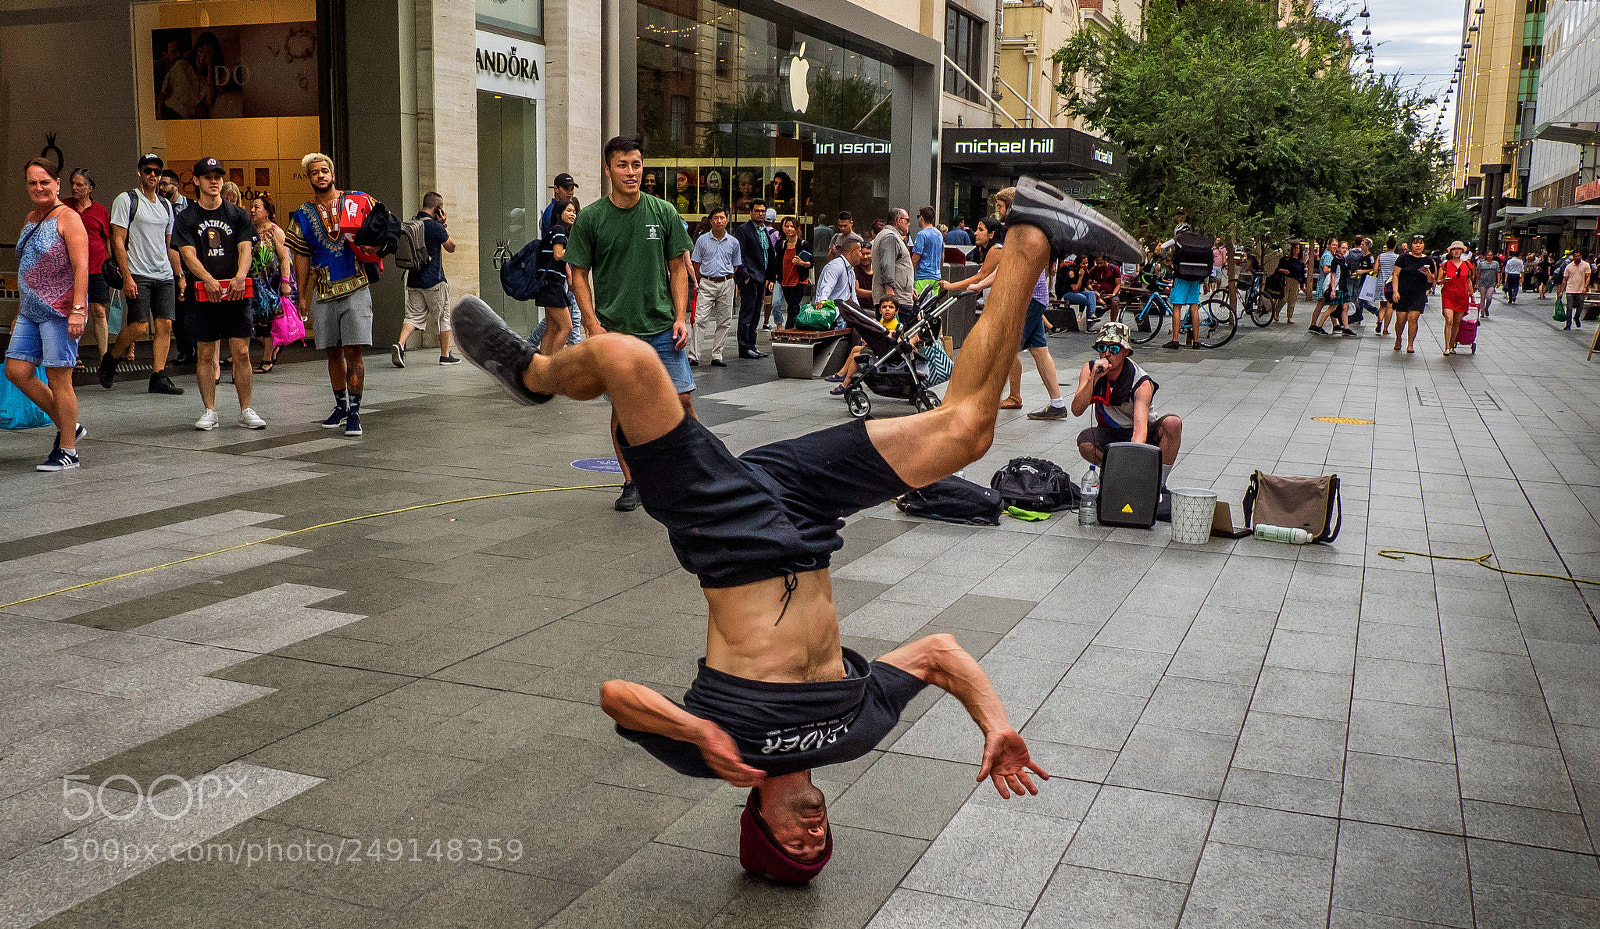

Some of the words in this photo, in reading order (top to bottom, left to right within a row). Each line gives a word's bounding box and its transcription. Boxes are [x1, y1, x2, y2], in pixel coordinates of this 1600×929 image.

[475, 46, 540, 81] ANDORA
[955, 138, 1026, 154] michael
[1030, 138, 1054, 154] hill
[199, 219, 233, 236] BATHING
[208, 248, 225, 257] APE
